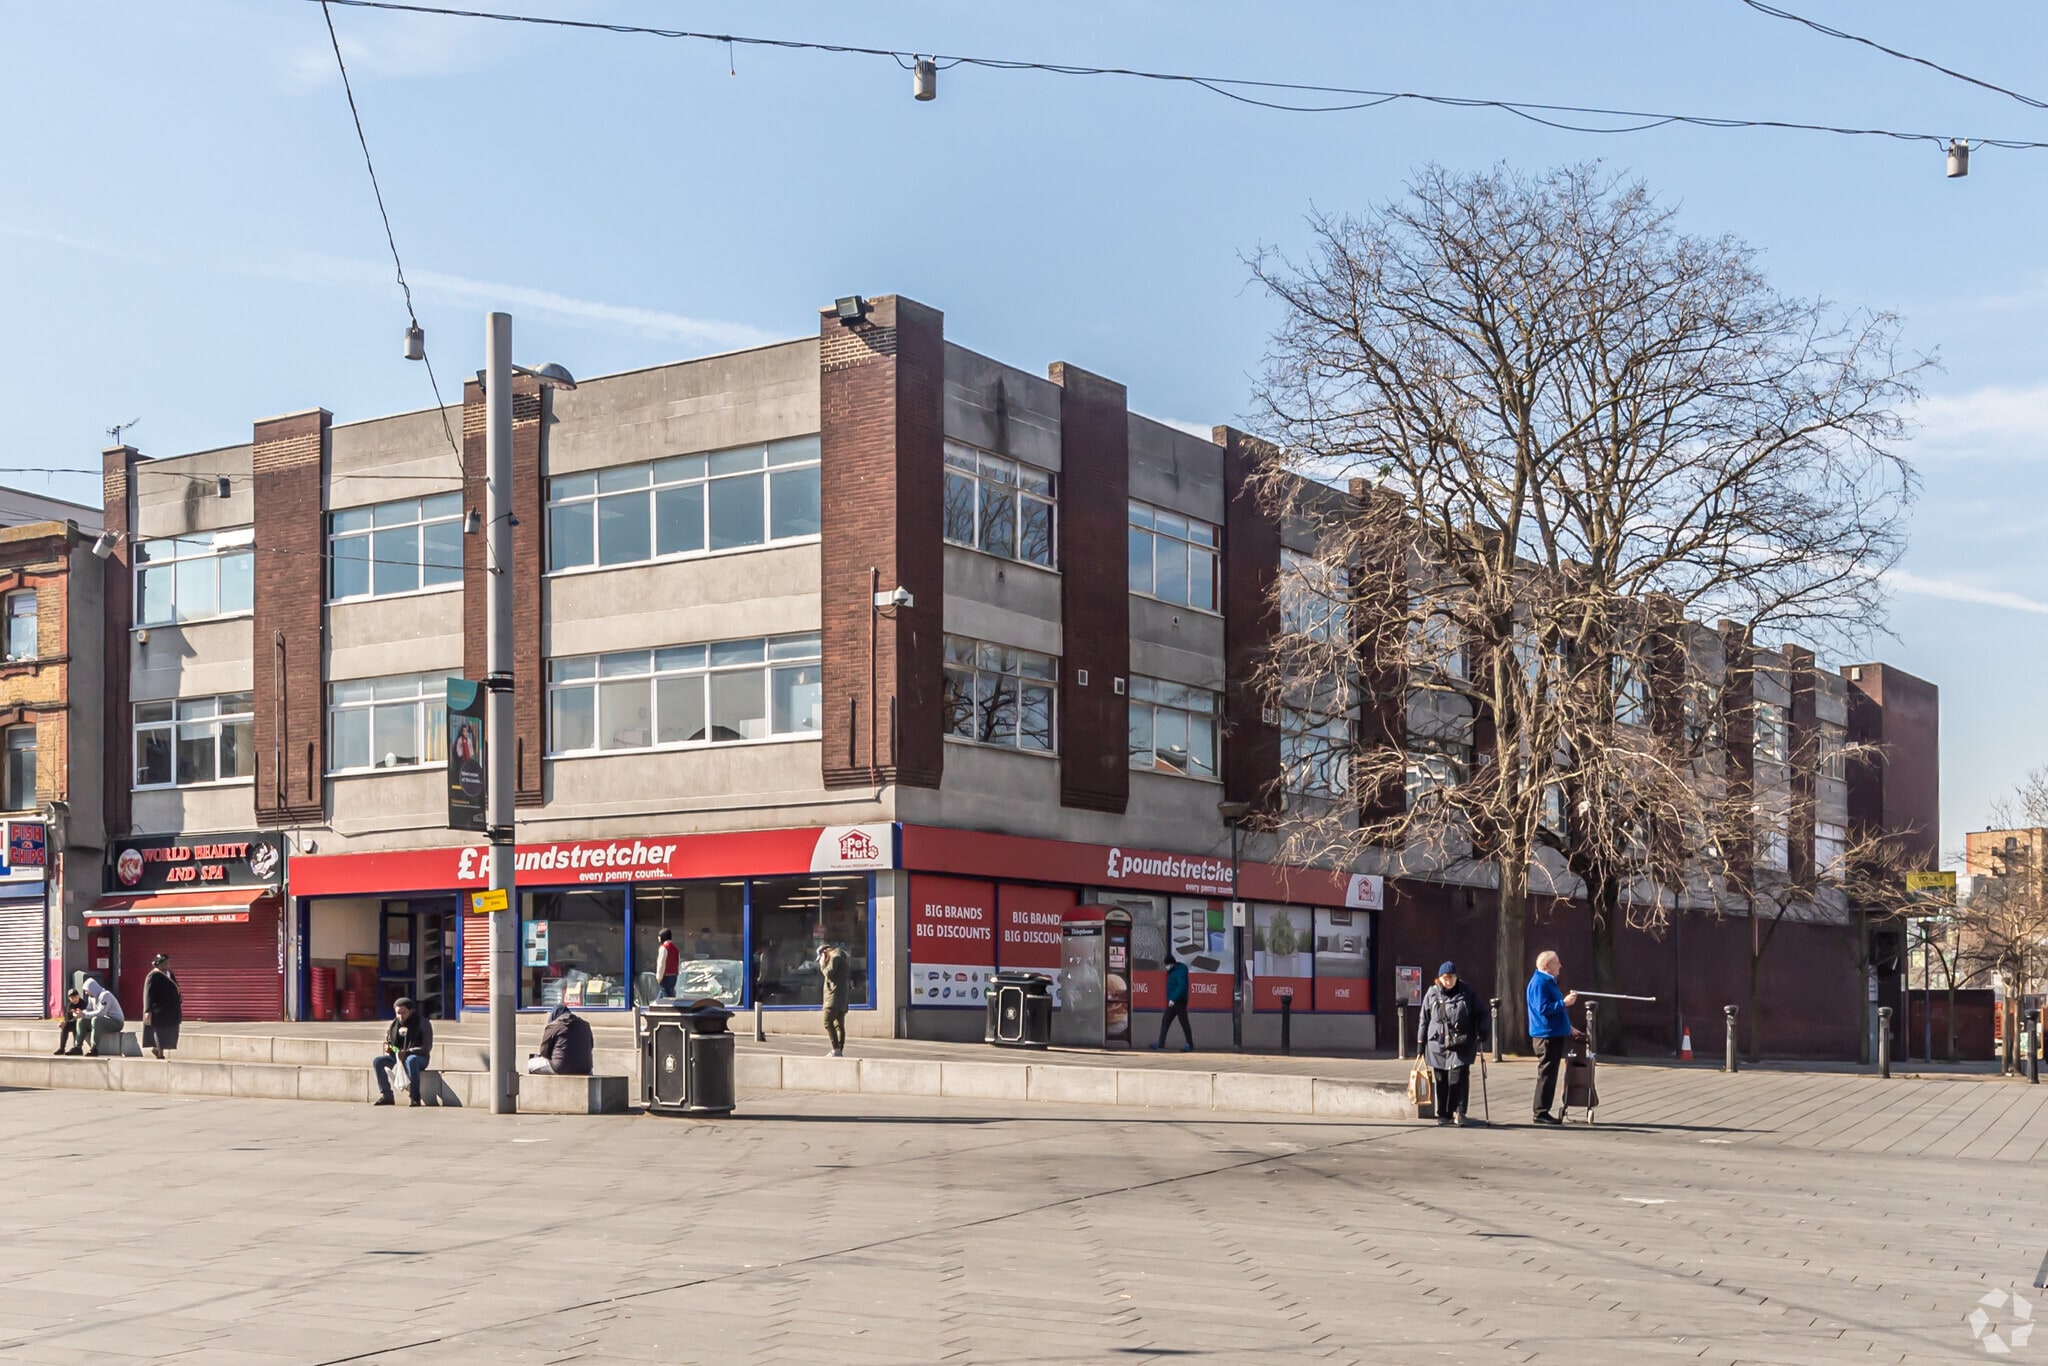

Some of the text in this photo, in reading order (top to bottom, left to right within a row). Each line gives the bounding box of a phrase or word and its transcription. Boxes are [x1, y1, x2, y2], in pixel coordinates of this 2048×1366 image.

[11, 825, 43, 842] FISH
[847, 838, 868, 849] Pet
[10, 847, 44, 864] CHIPS
[141, 843, 249, 862] WORLD BEAUTY
[847, 848, 868, 859] Hut
[457, 841, 677, 880] £pundstretcher
[1107, 848, 1239, 882] £poundstretche
[166, 865, 224, 881] AND SPA
[579, 868, 672, 883] every penny counts...
[1185, 884, 1200, 893] every
[1200, 885, 1217, 895] penny
[925, 904, 983, 920] BIG BRANDS
[1012, 911, 1062, 926] BIG BRAND
[916, 924, 991, 940] BIG DISCOUNTS
[1004, 930, 1062, 944] BIG DISCOUN
[1131, 982, 1148, 993] DING
[1191, 982, 1218, 994] STORAGE
[1272, 986, 1293, 996] GARDEN
[1335, 988, 1350, 998] HOME
